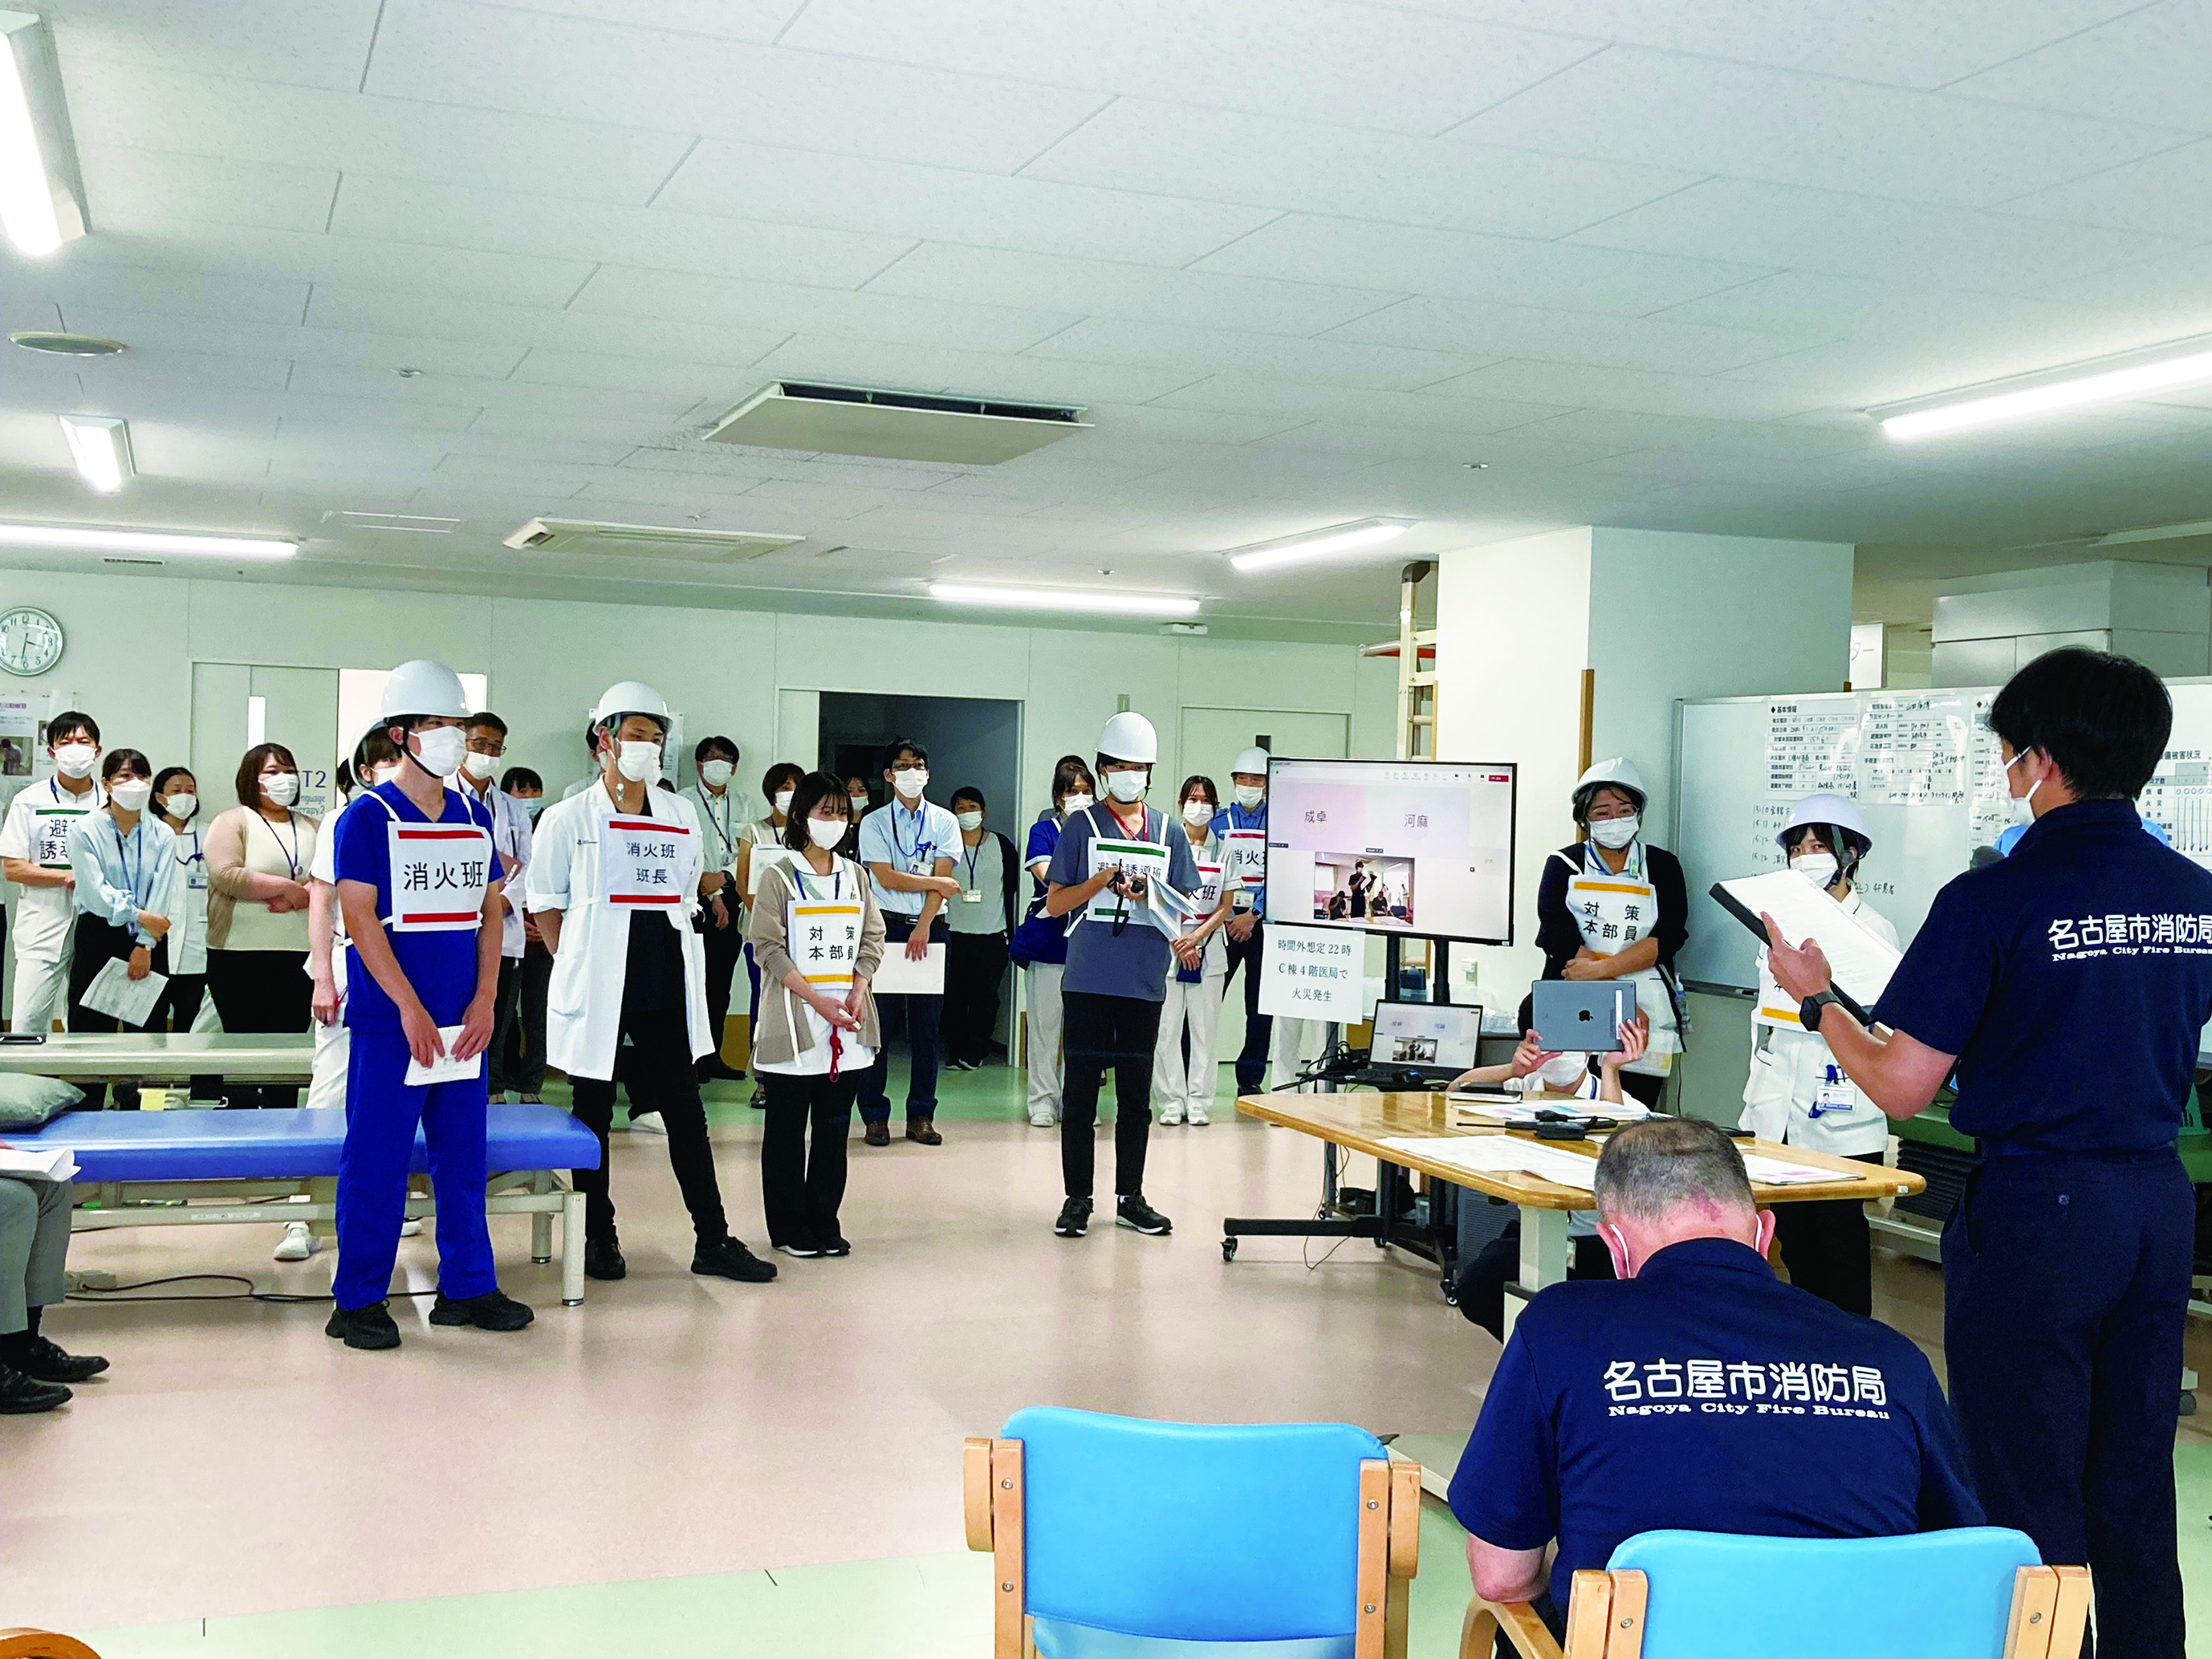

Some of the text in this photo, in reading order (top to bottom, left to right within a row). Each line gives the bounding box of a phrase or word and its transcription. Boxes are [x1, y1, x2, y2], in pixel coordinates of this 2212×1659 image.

[10, 617, 17, 626] 11
[48, 637, 53, 647] 3
[11, 655, 17, 665] 7
[35, 656, 41, 665] 5
[43, 649, 48, 657] 4
[22, 657, 29, 669] 6
[2161, 750, 2201, 761] 備被害状況
[298, 770, 327, 788] T2
[300, 795, 326, 805] nguage
[627, 842, 676, 859] 消火班
[1234, 849, 1266, 866] 消火
[404, 860, 484, 892] 消火班
[636, 868, 668, 884] 班長
[1096, 862, 1161, 880] 避誘導班
[1189, 884, 1217, 901] 火班
[1583, 919, 1637, 941] 本部員
[2047, 913, 2212, 950] 名古屋市消防局
[809, 945, 854, 961] 本部員
[2051, 949, 2108, 962] Nagoya
[2112, 946, 2140, 956] City
[2142, 946, 2170, 954] Fire
[1291, 987, 1332, 1002] 火災発生
[1603, 1358, 1887, 1406] 名古屋市消防局
[1608, 1402, 1891, 1420] Nagoya City Fire Bureau
